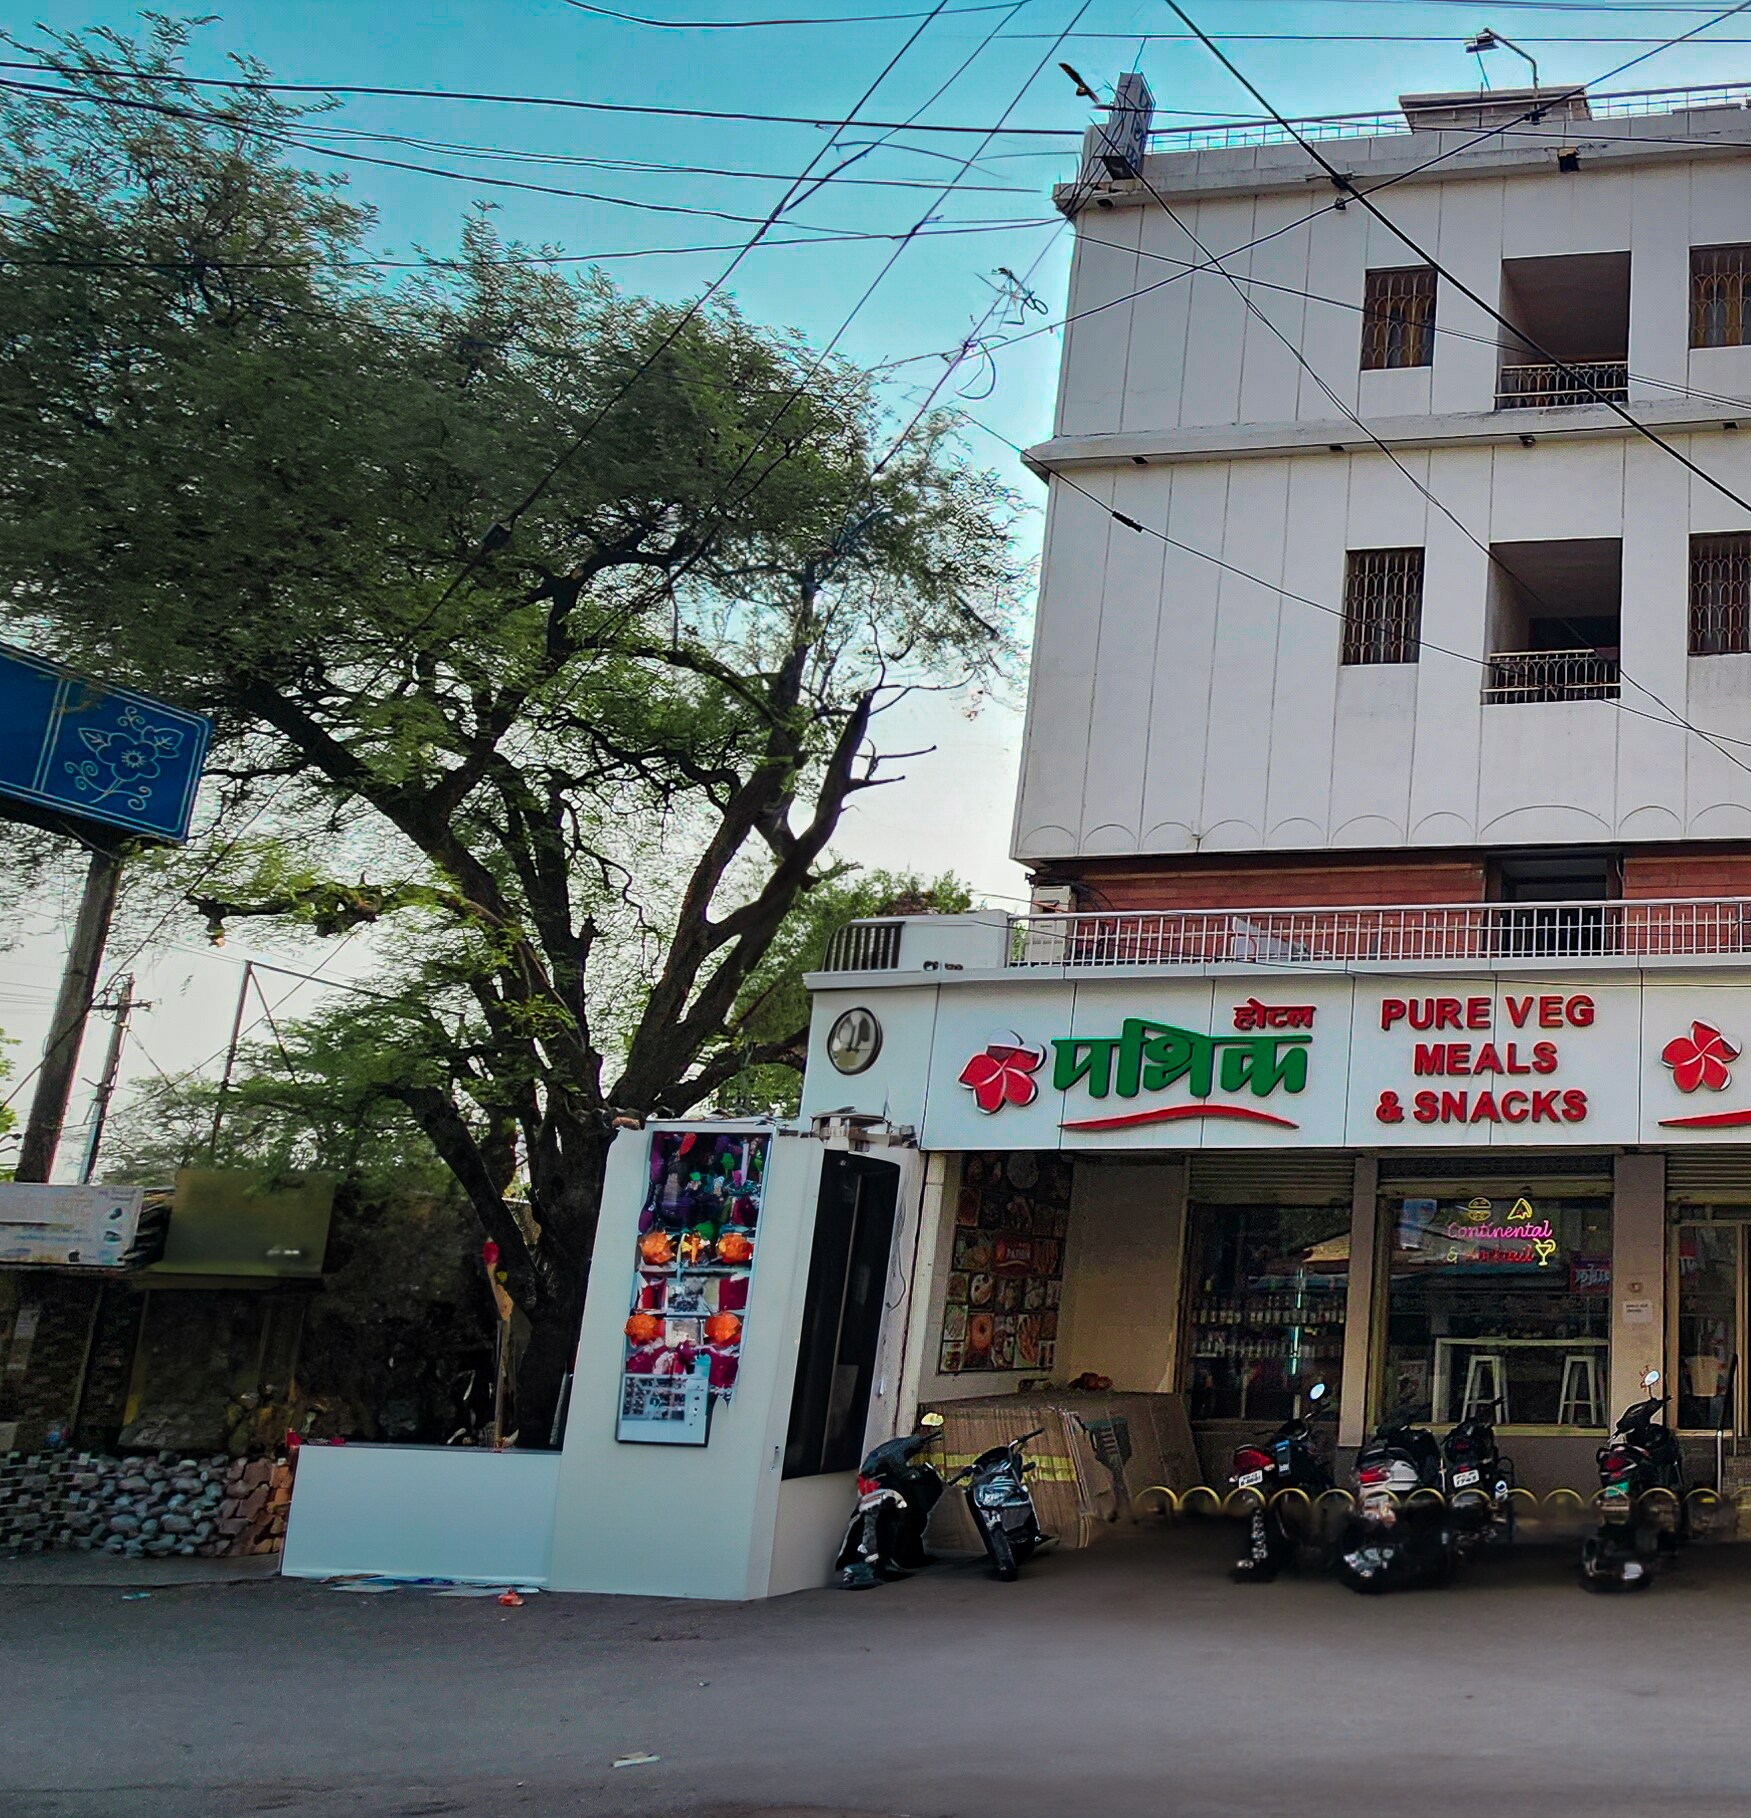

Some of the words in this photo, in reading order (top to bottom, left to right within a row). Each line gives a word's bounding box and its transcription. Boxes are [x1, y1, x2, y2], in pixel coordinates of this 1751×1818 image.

[1232, 998, 1316, 1030] होटल
[1380, 997, 1491, 1031] PURE
[1505, 994, 1595, 1028] VEG
[1051, 1017, 1312, 1098] पथिक
[1413, 1041, 1558, 1075] MEALS
[1376, 1090, 1405, 1122] &
[1413, 1089, 1588, 1123] SNACKS
[1447, 1219, 1553, 1239] Continental
